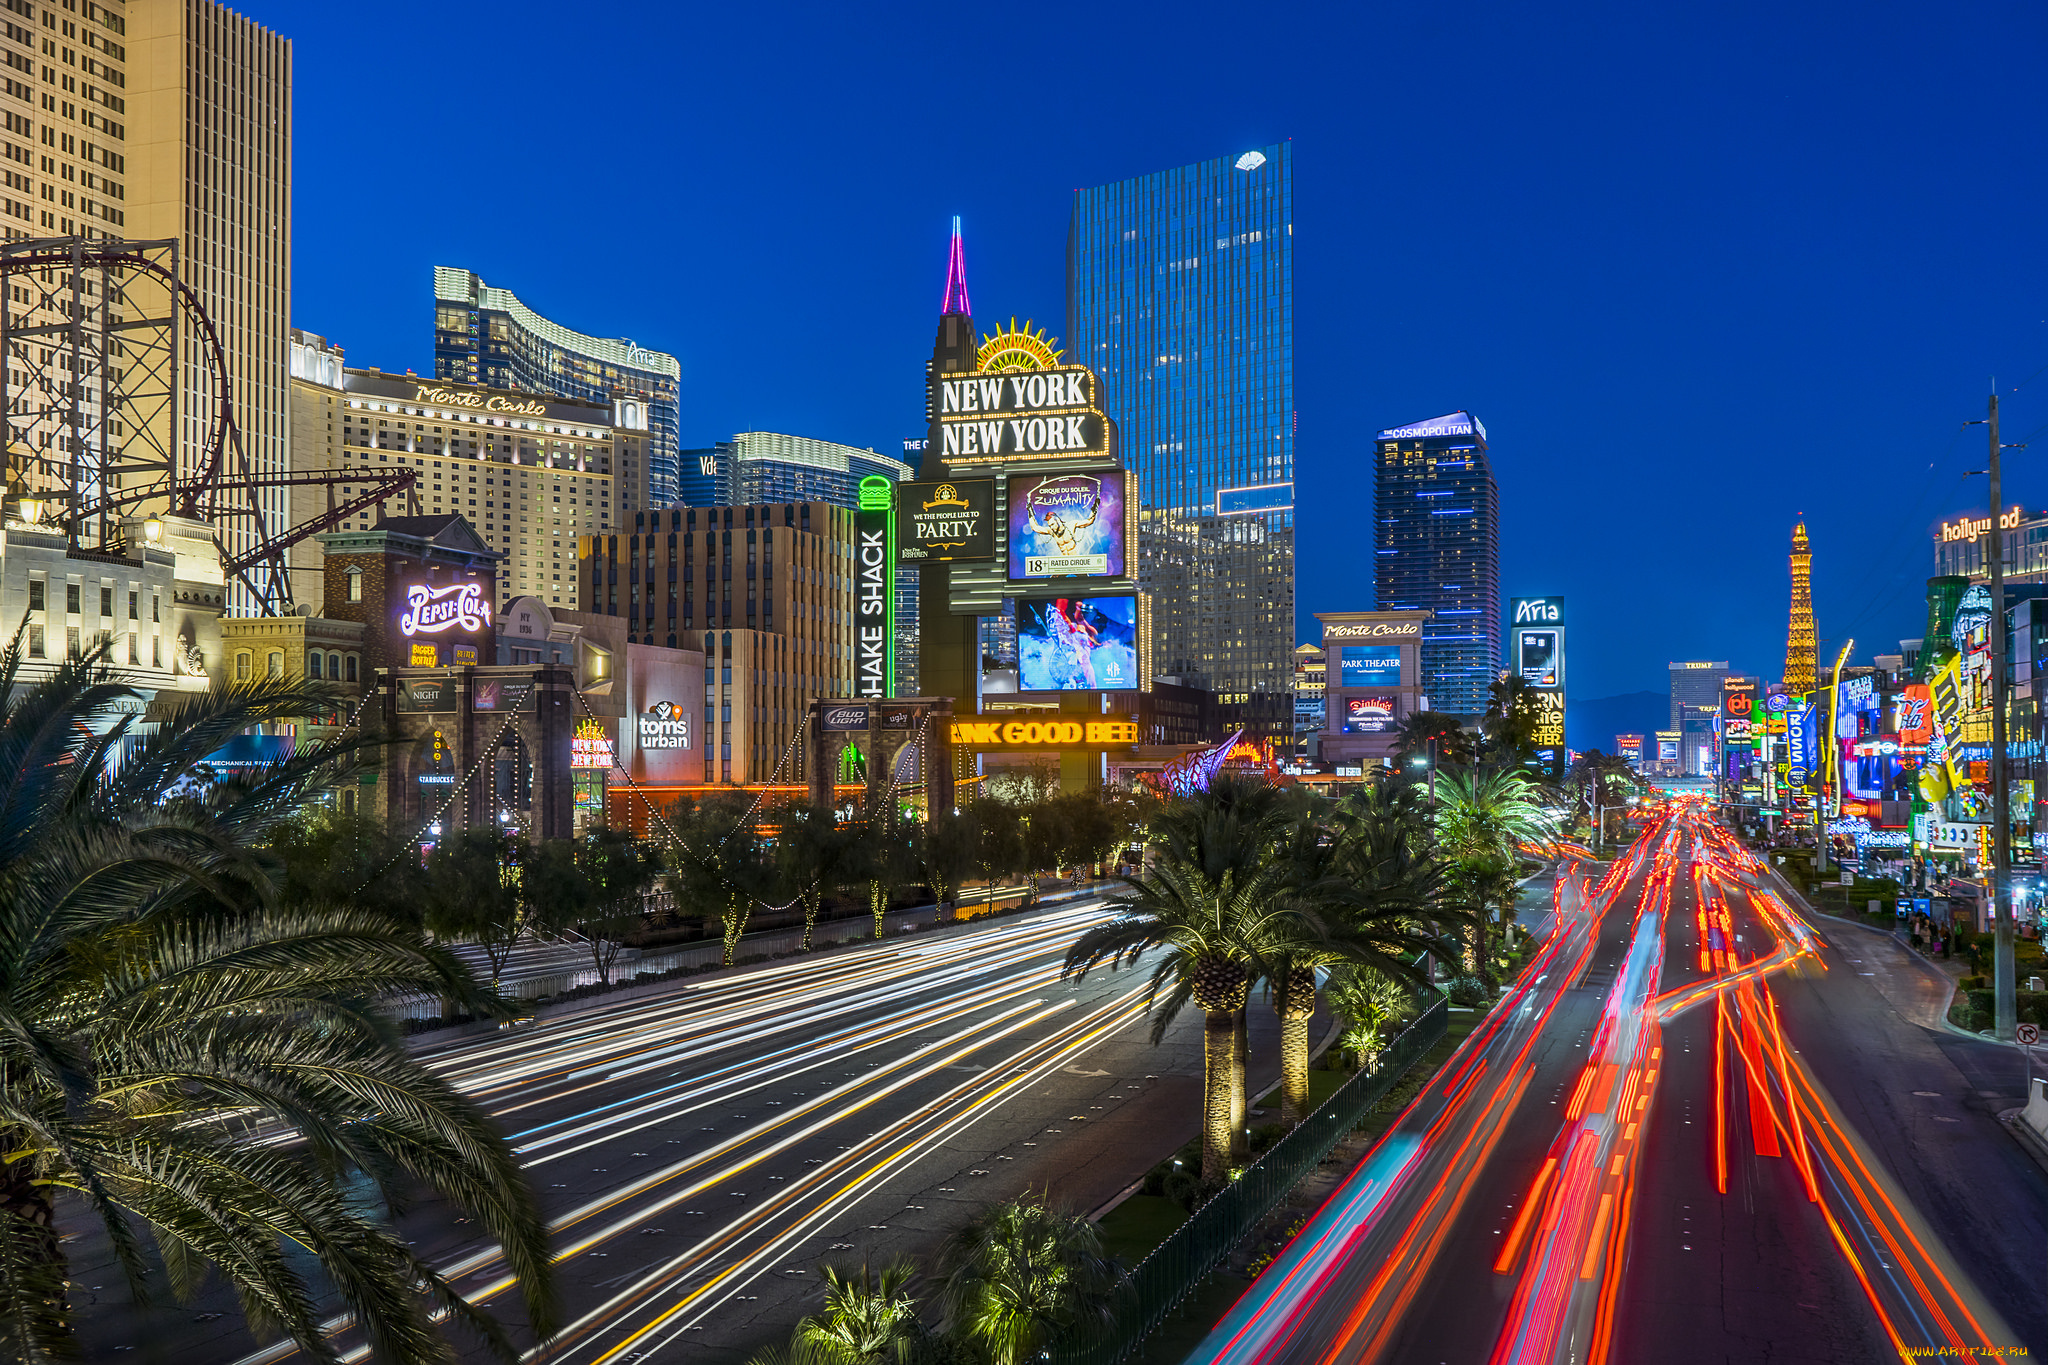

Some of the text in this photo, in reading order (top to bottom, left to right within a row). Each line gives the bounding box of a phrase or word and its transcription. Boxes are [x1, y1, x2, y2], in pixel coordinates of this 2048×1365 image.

[625, 339, 656, 366] Aria
[941, 371, 1087, 413] NEW YORK
[415, 385, 546, 416] Monte Carlo
[941, 415, 1087, 456] NEW YORK
[1393, 425, 1472, 438] COSMOPOLITAN
[903, 440, 920, 450] THE
[1039, 487, 1060, 495] CIRQUE
[1034, 492, 1095, 509] ZUMANITY
[936, 512, 957, 520] PEOPLE
[916, 520, 978, 539] PARTY.
[1050, 558, 1090, 567] RATED CIRQUE
[862, 529, 883, 615] SHACK
[520, 612, 530, 622] NY
[1516, 600, 1559, 623] Aria
[519, 624, 532, 634] 1936
[1324, 623, 1418, 637] Monte Carlo
[412, 644, 436, 655] BIGGER
[1341, 659, 1401, 668] PARK THEATER
[413, 691, 440, 700] NIGHT
[889, 712, 908, 723] ugly
[639, 718, 687, 735] toms
[1002, 722, 1084, 743] GOOD
[641, 734, 688, 748] urban
[1789, 714, 1804, 763] ROSS
[572, 739, 613, 752] NEW YORK
[572, 753, 613, 766] NEW YORK
[419, 776, 451, 784] STARBUCKS
